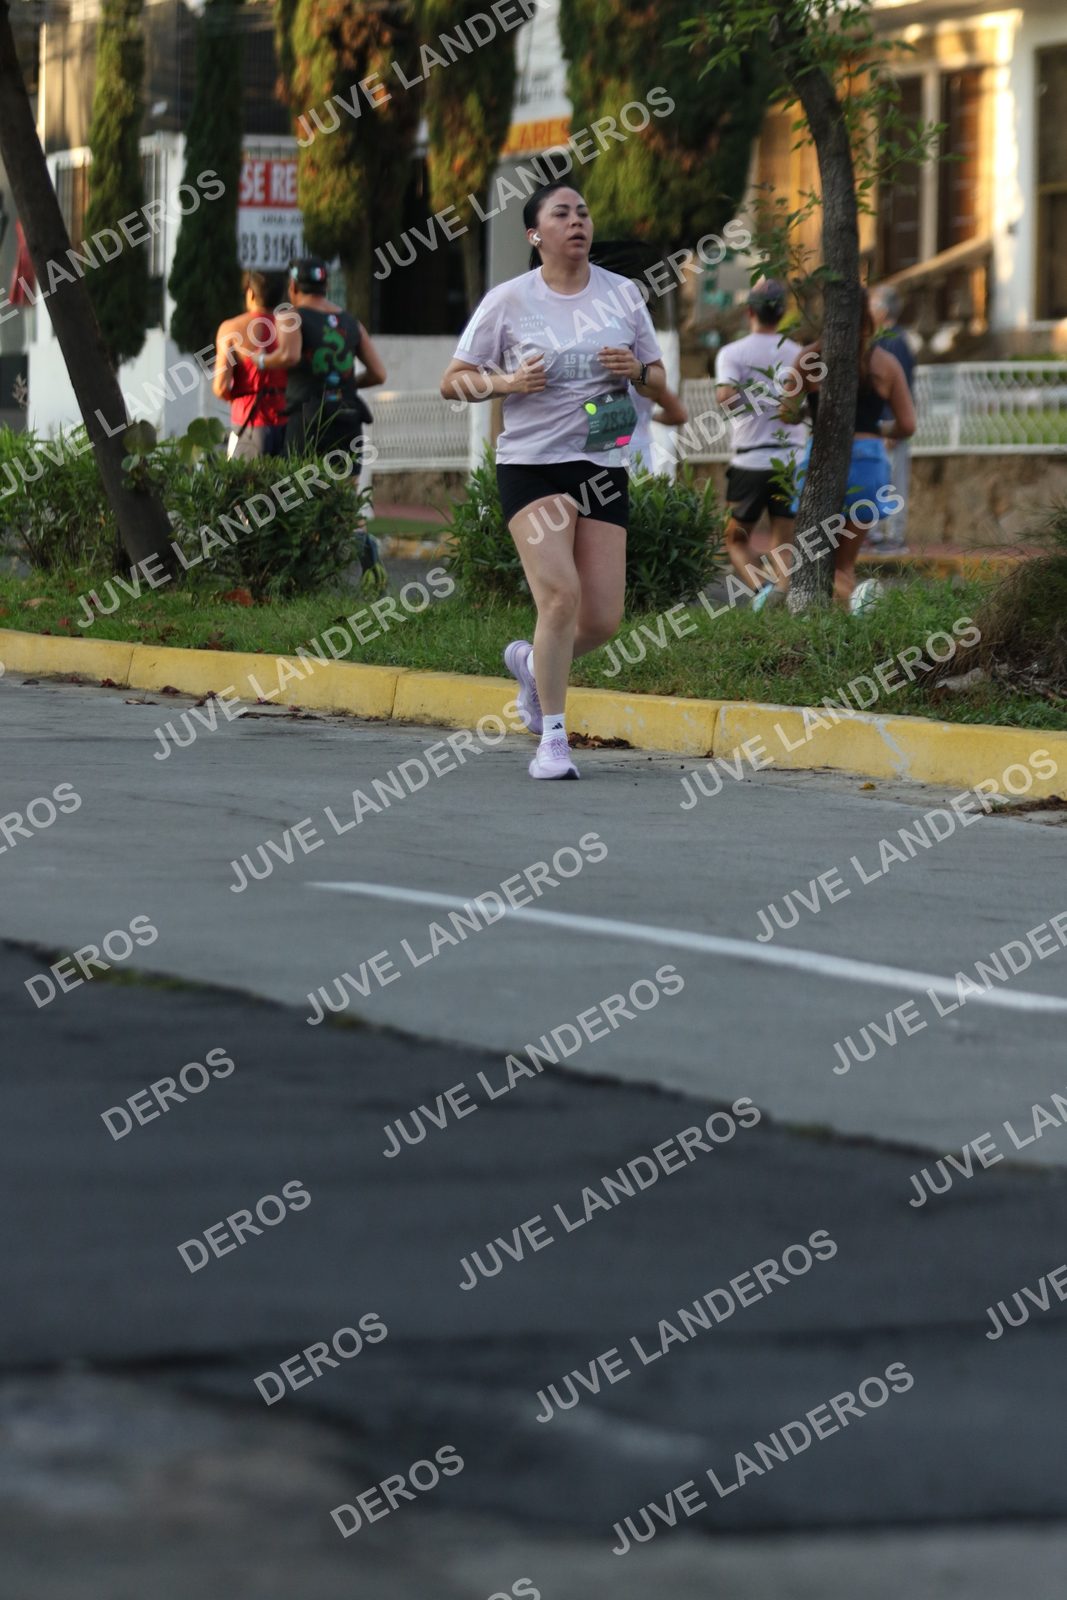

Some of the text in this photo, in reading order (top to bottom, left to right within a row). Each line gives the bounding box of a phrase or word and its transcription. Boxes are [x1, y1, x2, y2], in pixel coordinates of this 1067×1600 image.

[240, 162, 266, 202] SE
[563, 353, 577, 365] 15
[578, 353, 594, 379] K
